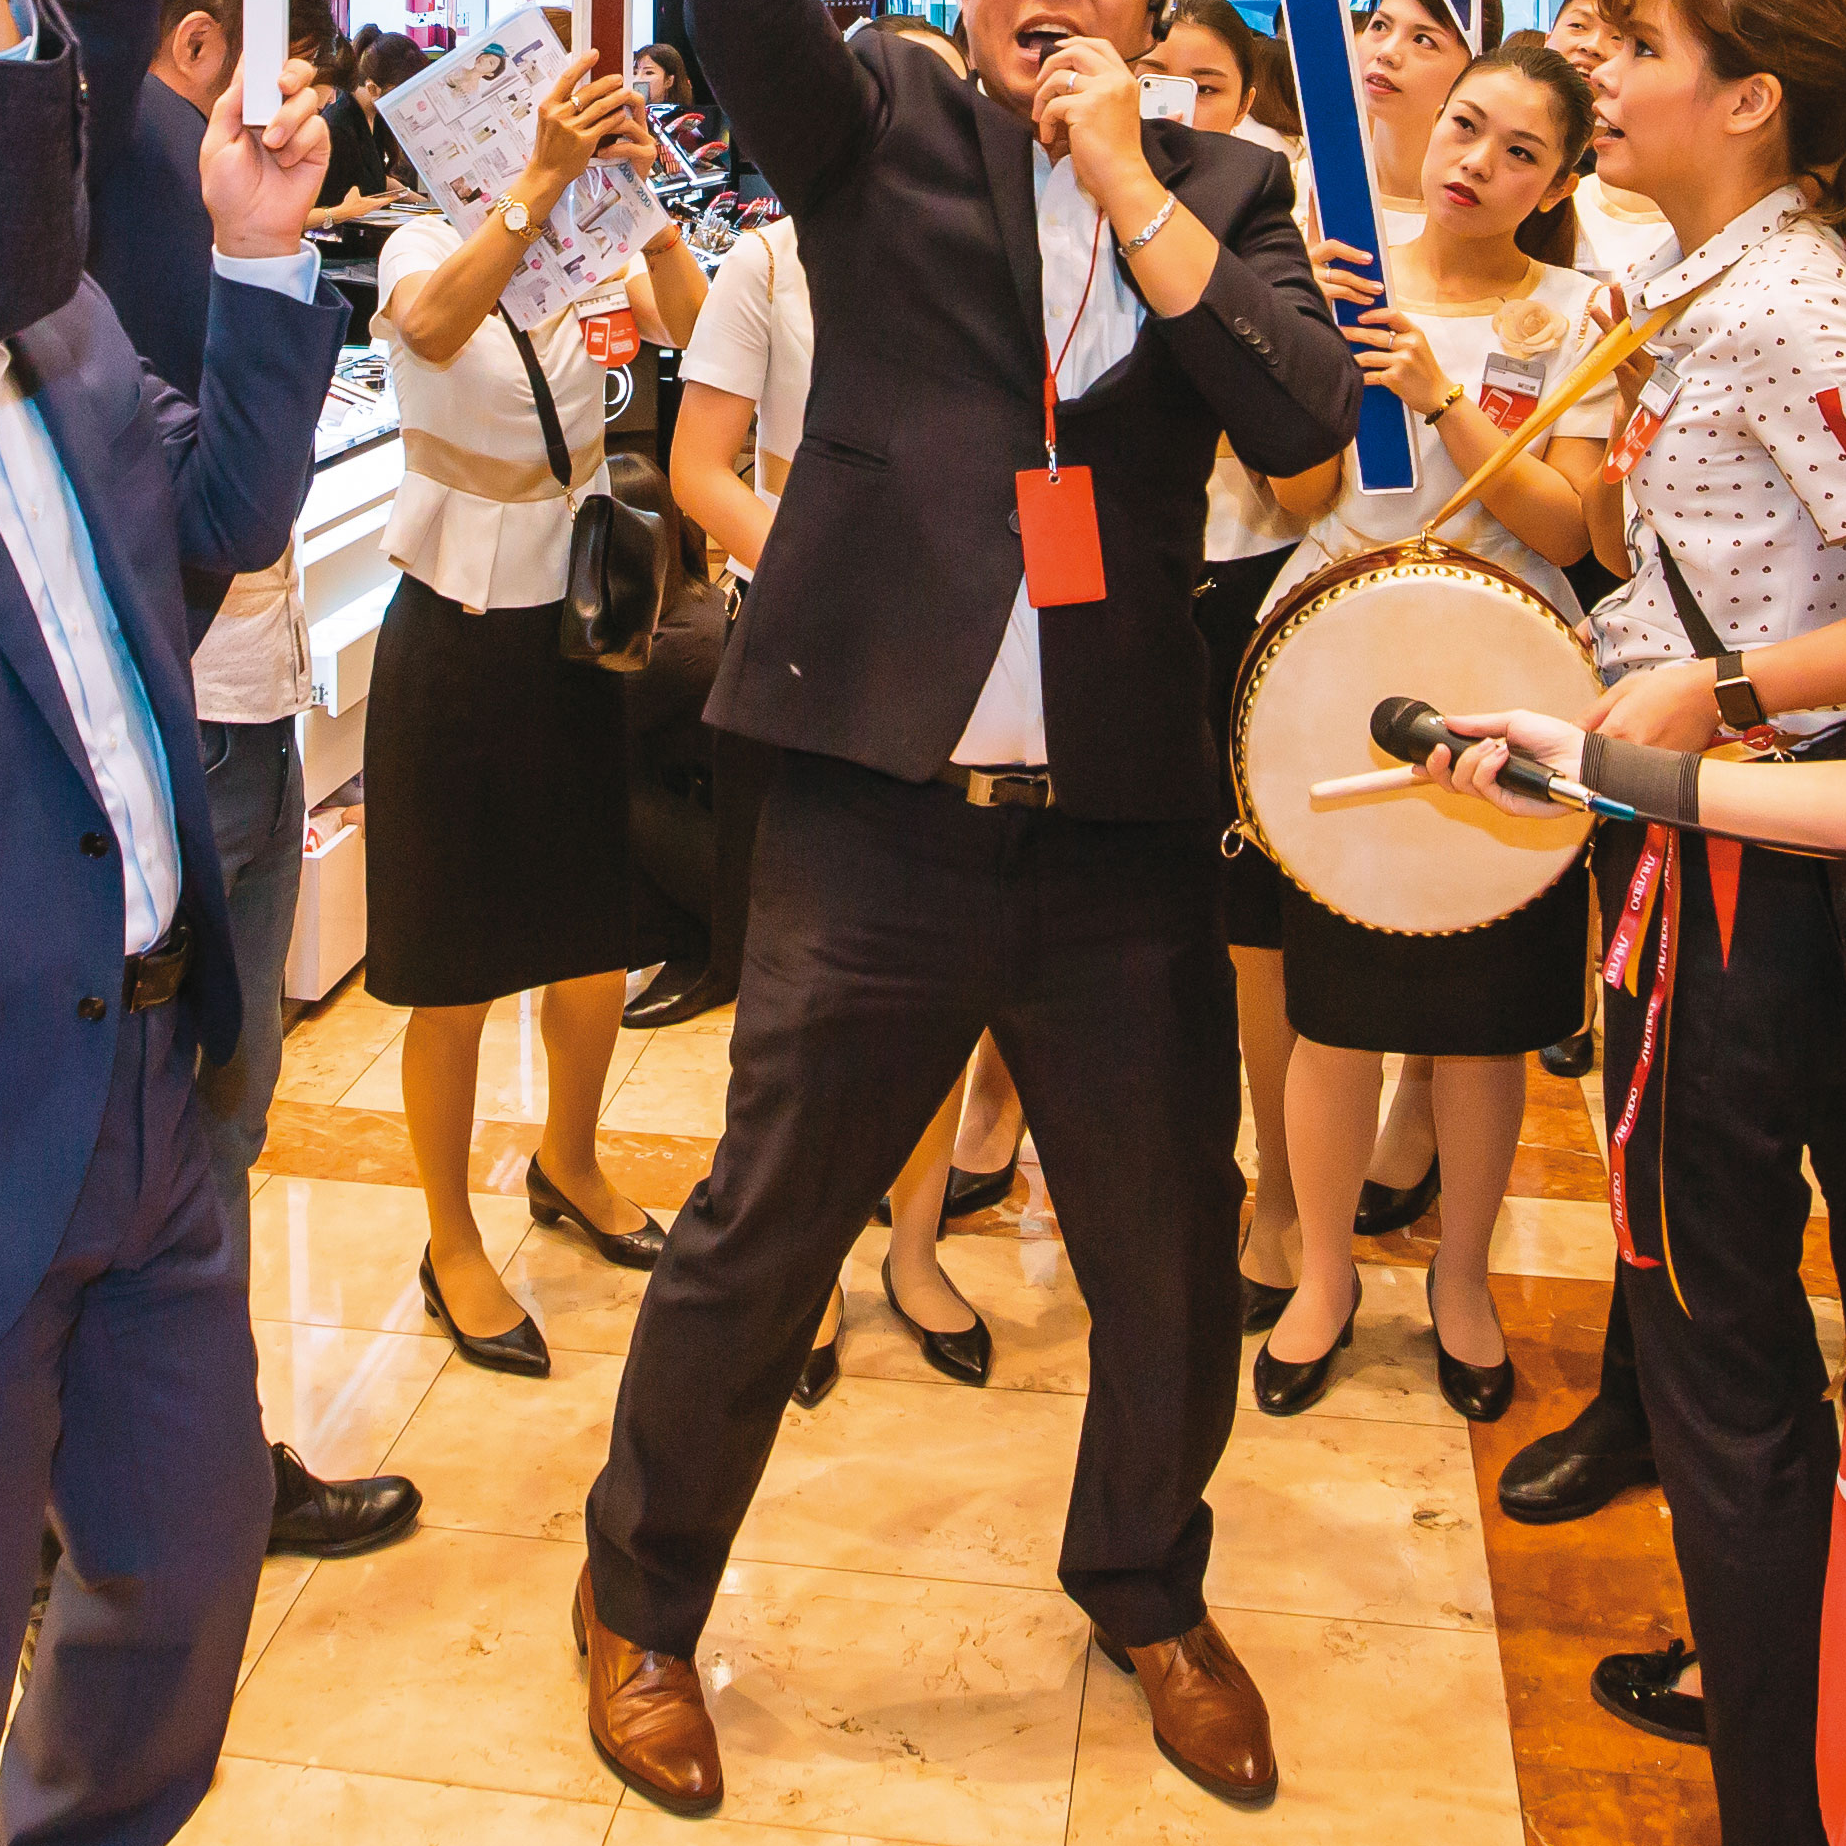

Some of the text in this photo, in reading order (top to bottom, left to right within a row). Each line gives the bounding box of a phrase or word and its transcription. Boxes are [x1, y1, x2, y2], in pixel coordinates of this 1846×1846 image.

[1630, 849, 1656, 912] SHISEIDO
[1614, 1087, 1639, 1150] SHISEIDO
[1612, 1171, 1626, 1233] SHISEIDO
